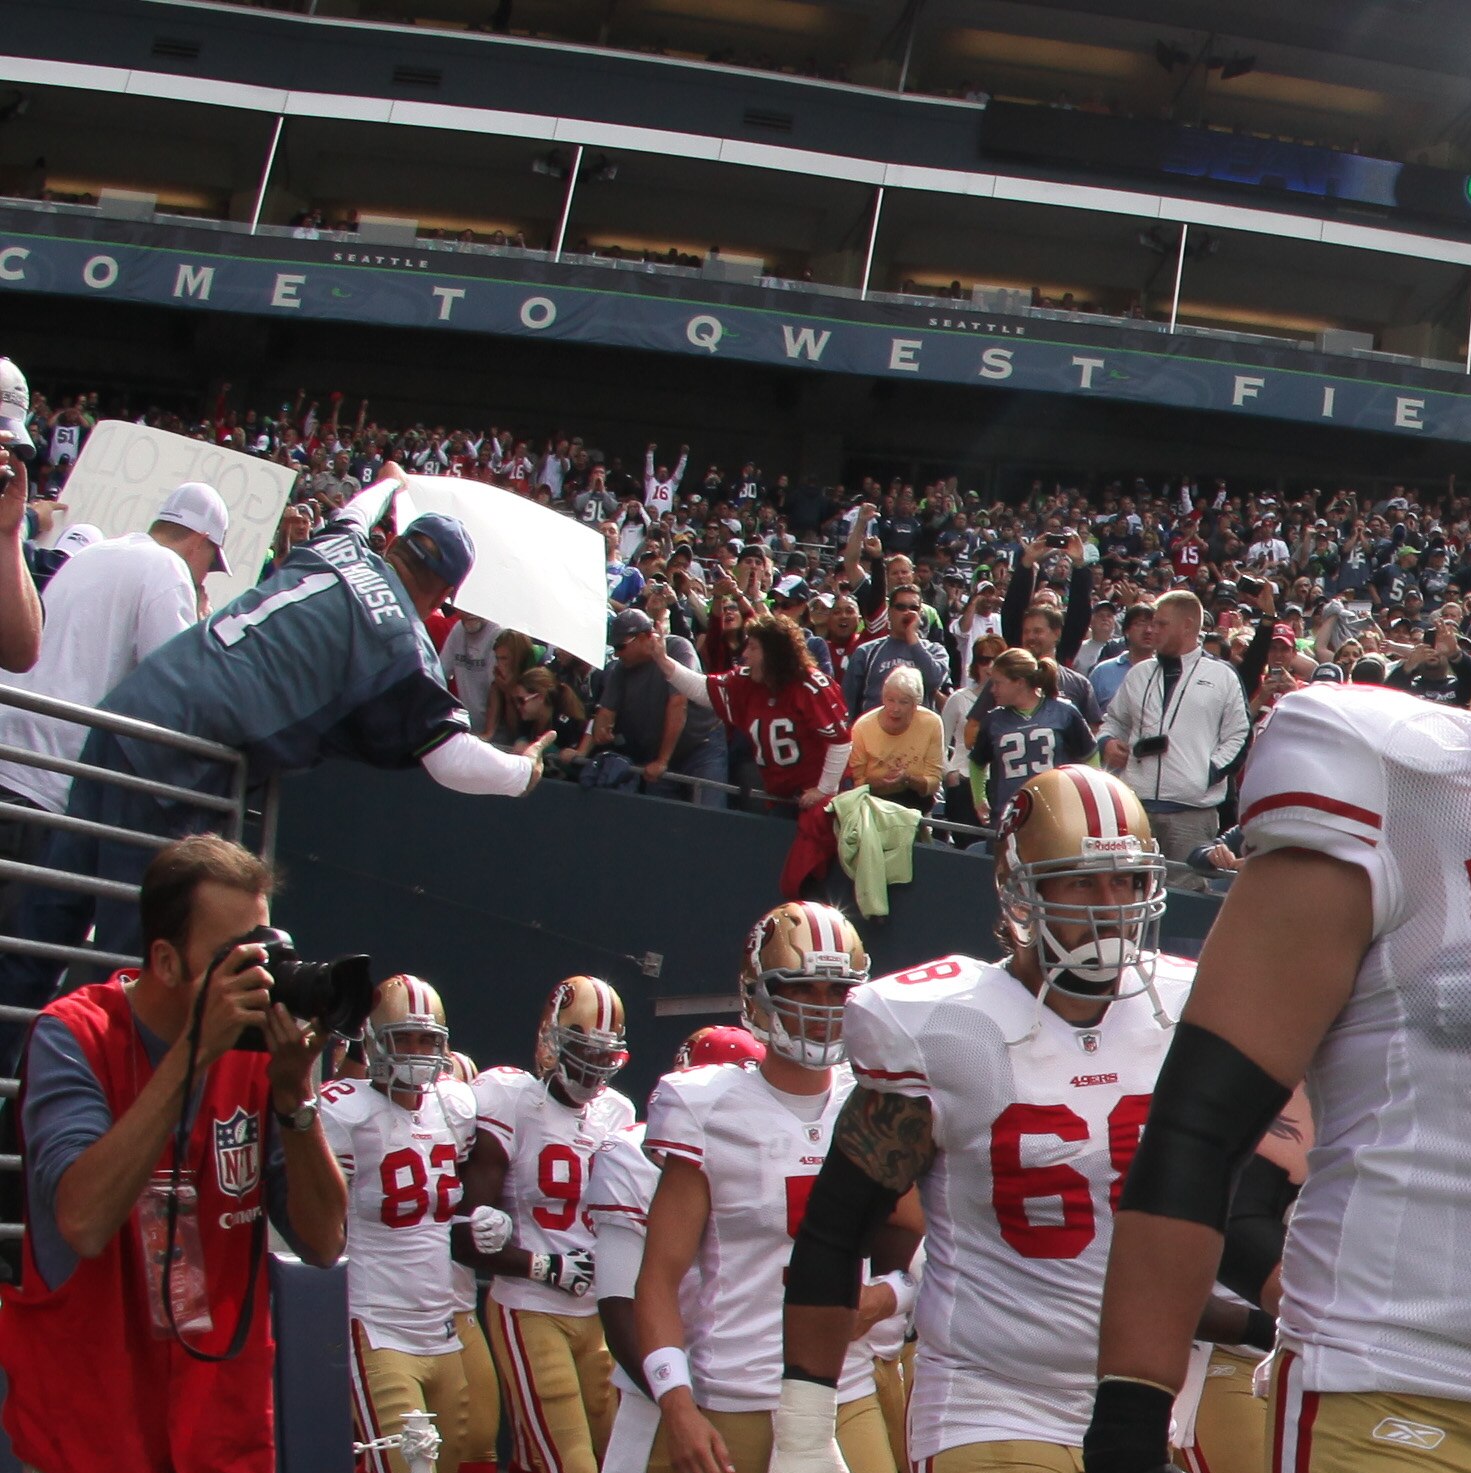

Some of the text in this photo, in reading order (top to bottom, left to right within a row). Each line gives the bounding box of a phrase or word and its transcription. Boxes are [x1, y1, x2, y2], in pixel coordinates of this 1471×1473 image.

[334, 253, 429, 269] SEATTLE
[0, 246, 306, 309] COME
[433, 286, 558, 330] TO
[687, 315, 1105, 389] QWEST
[929, 318, 1027, 336] SEATTLE
[652, 486, 668, 500] 16
[1180, 546, 1199, 564] 15
[749, 717, 799, 767] 16
[999, 729, 1056, 780] 23
[1094, 840, 1128, 852] Riddell
[1070, 1072, 1118, 1088] 49ERS
[379, 1144, 462, 1228] 82
[533, 1144, 597, 1237] 9
